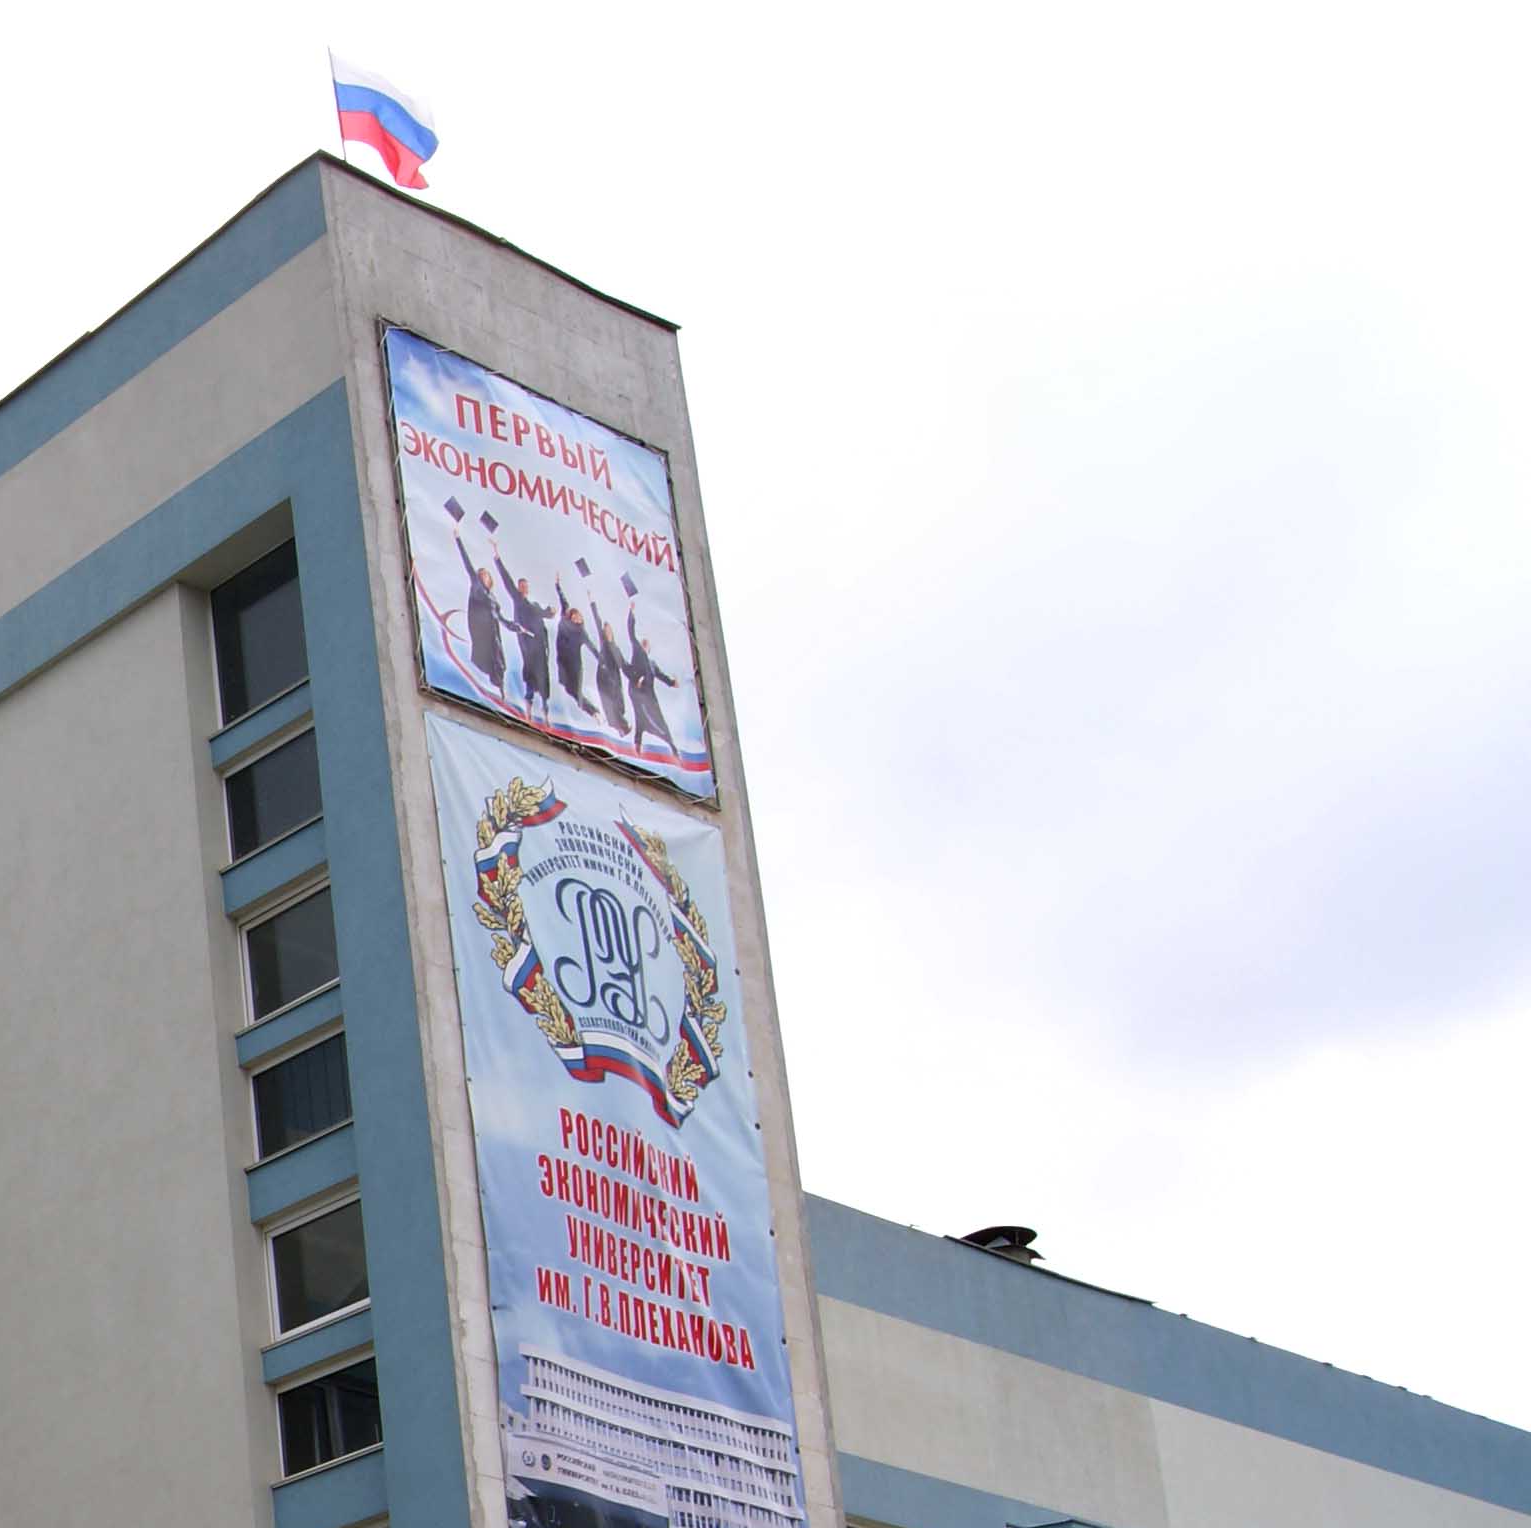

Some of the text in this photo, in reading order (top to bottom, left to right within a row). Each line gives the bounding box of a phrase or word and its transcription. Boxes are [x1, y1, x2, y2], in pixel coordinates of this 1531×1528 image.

[455, 393, 612, 490] ПЕРВЫЙ
[400, 420, 675, 573] ЭКОНОМИЧЕСКИЙ
[560, 1108, 699, 1203] РОССИЙСКИЙ
[538, 1154, 731, 1262] ЭКОНОМИЧЕСКИЙ
[537, 1267, 577, 1313] ИМ.
[567, 1214, 710, 1307] УНИВЕРСИТЕТ
